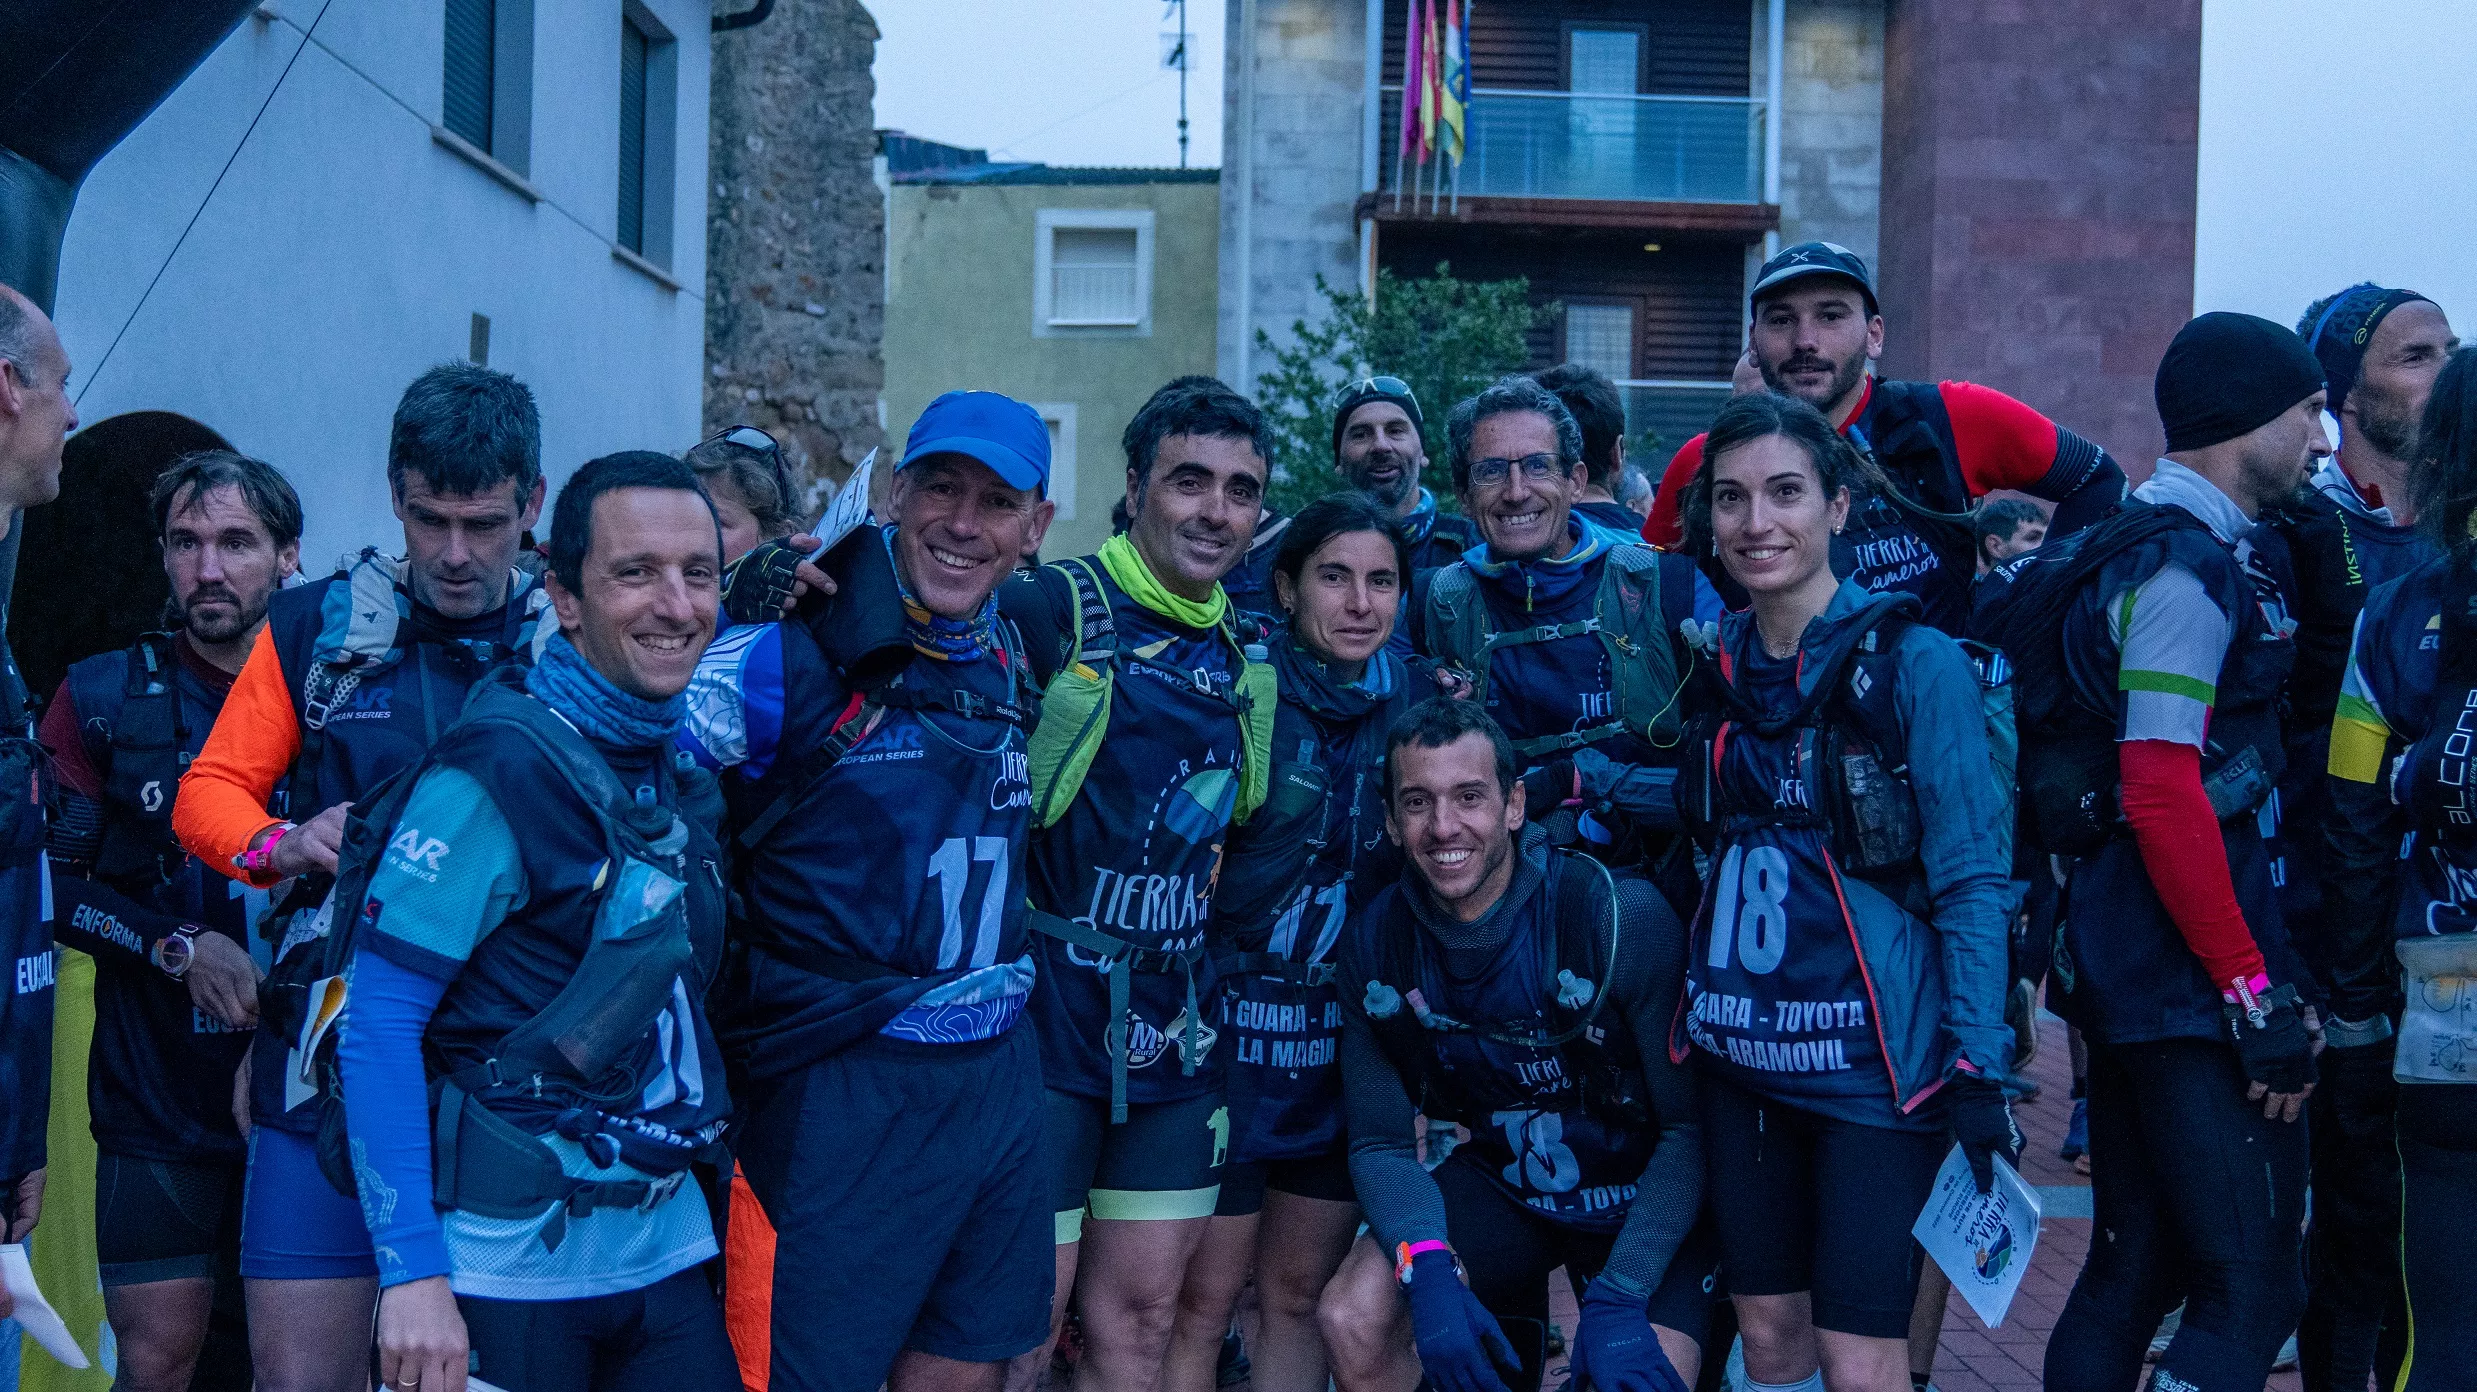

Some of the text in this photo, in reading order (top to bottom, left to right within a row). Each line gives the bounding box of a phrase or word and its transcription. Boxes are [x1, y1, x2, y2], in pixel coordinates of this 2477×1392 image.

[1853, 535, 1918, 567] TIERRA
[355, 711, 391, 719] SERIES
[862, 724, 922, 750] AR
[886, 750, 924, 761] SERIES
[390, 829, 450, 871] AR
[928, 836, 1009, 970] 17
[1088, 866, 1197, 932] TIERRA
[1708, 844, 1788, 975] 18
[71, 904, 143, 954] ENFORMA
[1236, 1000, 1306, 1032] GUARA
[1776, 1000, 1866, 1033] TOYOTA
[1237, 1036, 1264, 1065] LA
[1271, 1037, 1335, 1067] MAGIA
[1965, 1202, 1972, 1213] DE
[1978, 1190, 2009, 1240] TIERRA
[1953, 1214, 1966, 1234] RUTA
